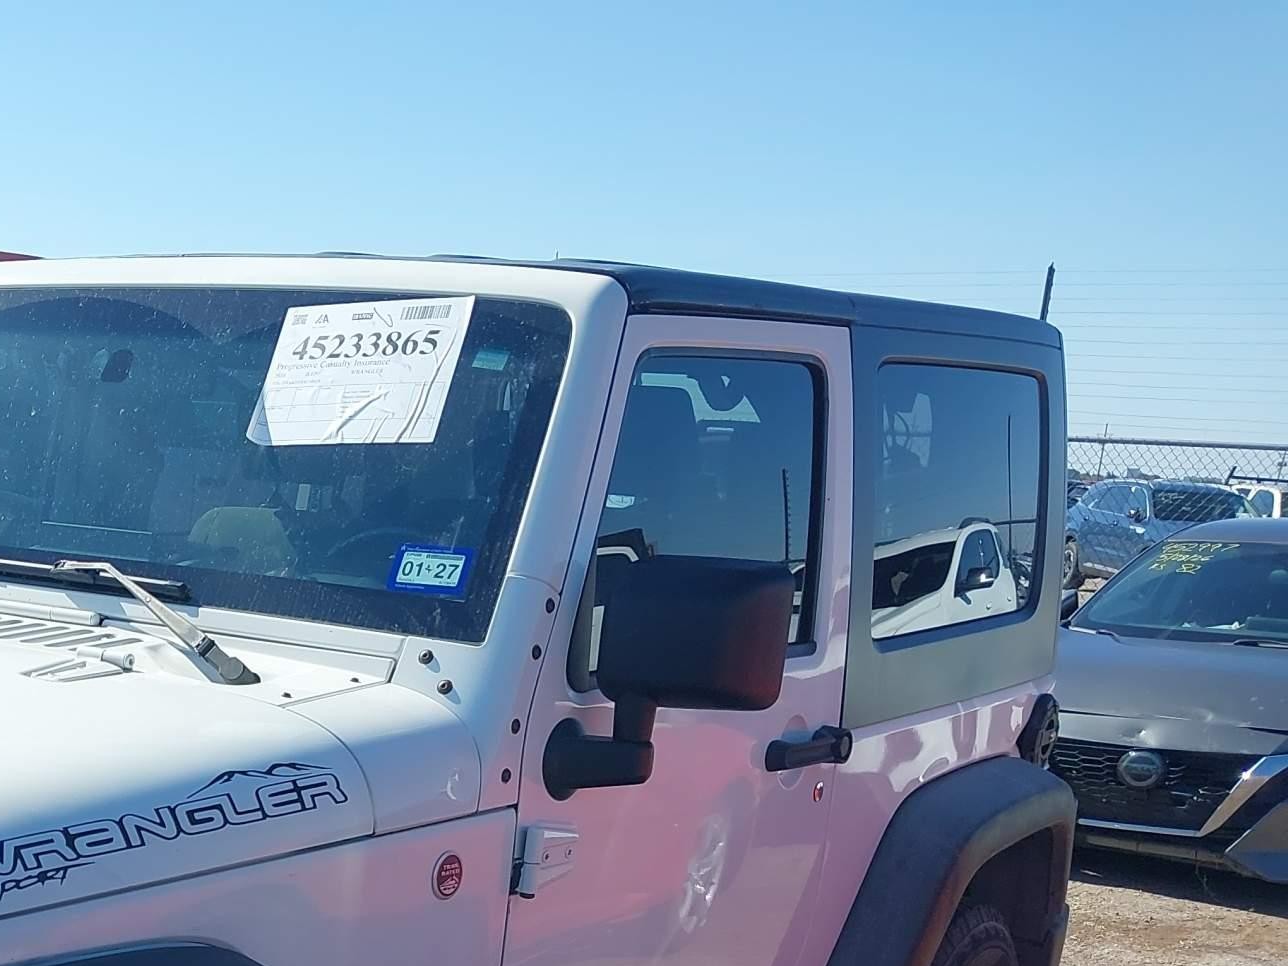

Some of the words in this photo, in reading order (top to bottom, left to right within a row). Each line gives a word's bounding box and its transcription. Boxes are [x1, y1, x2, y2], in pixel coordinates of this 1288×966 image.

[291, 329, 441, 361] 45233865
[276, 362, 318, 372] Progressive
[319, 360, 351, 369] Casualty
[353, 358, 391, 367] Insurance
